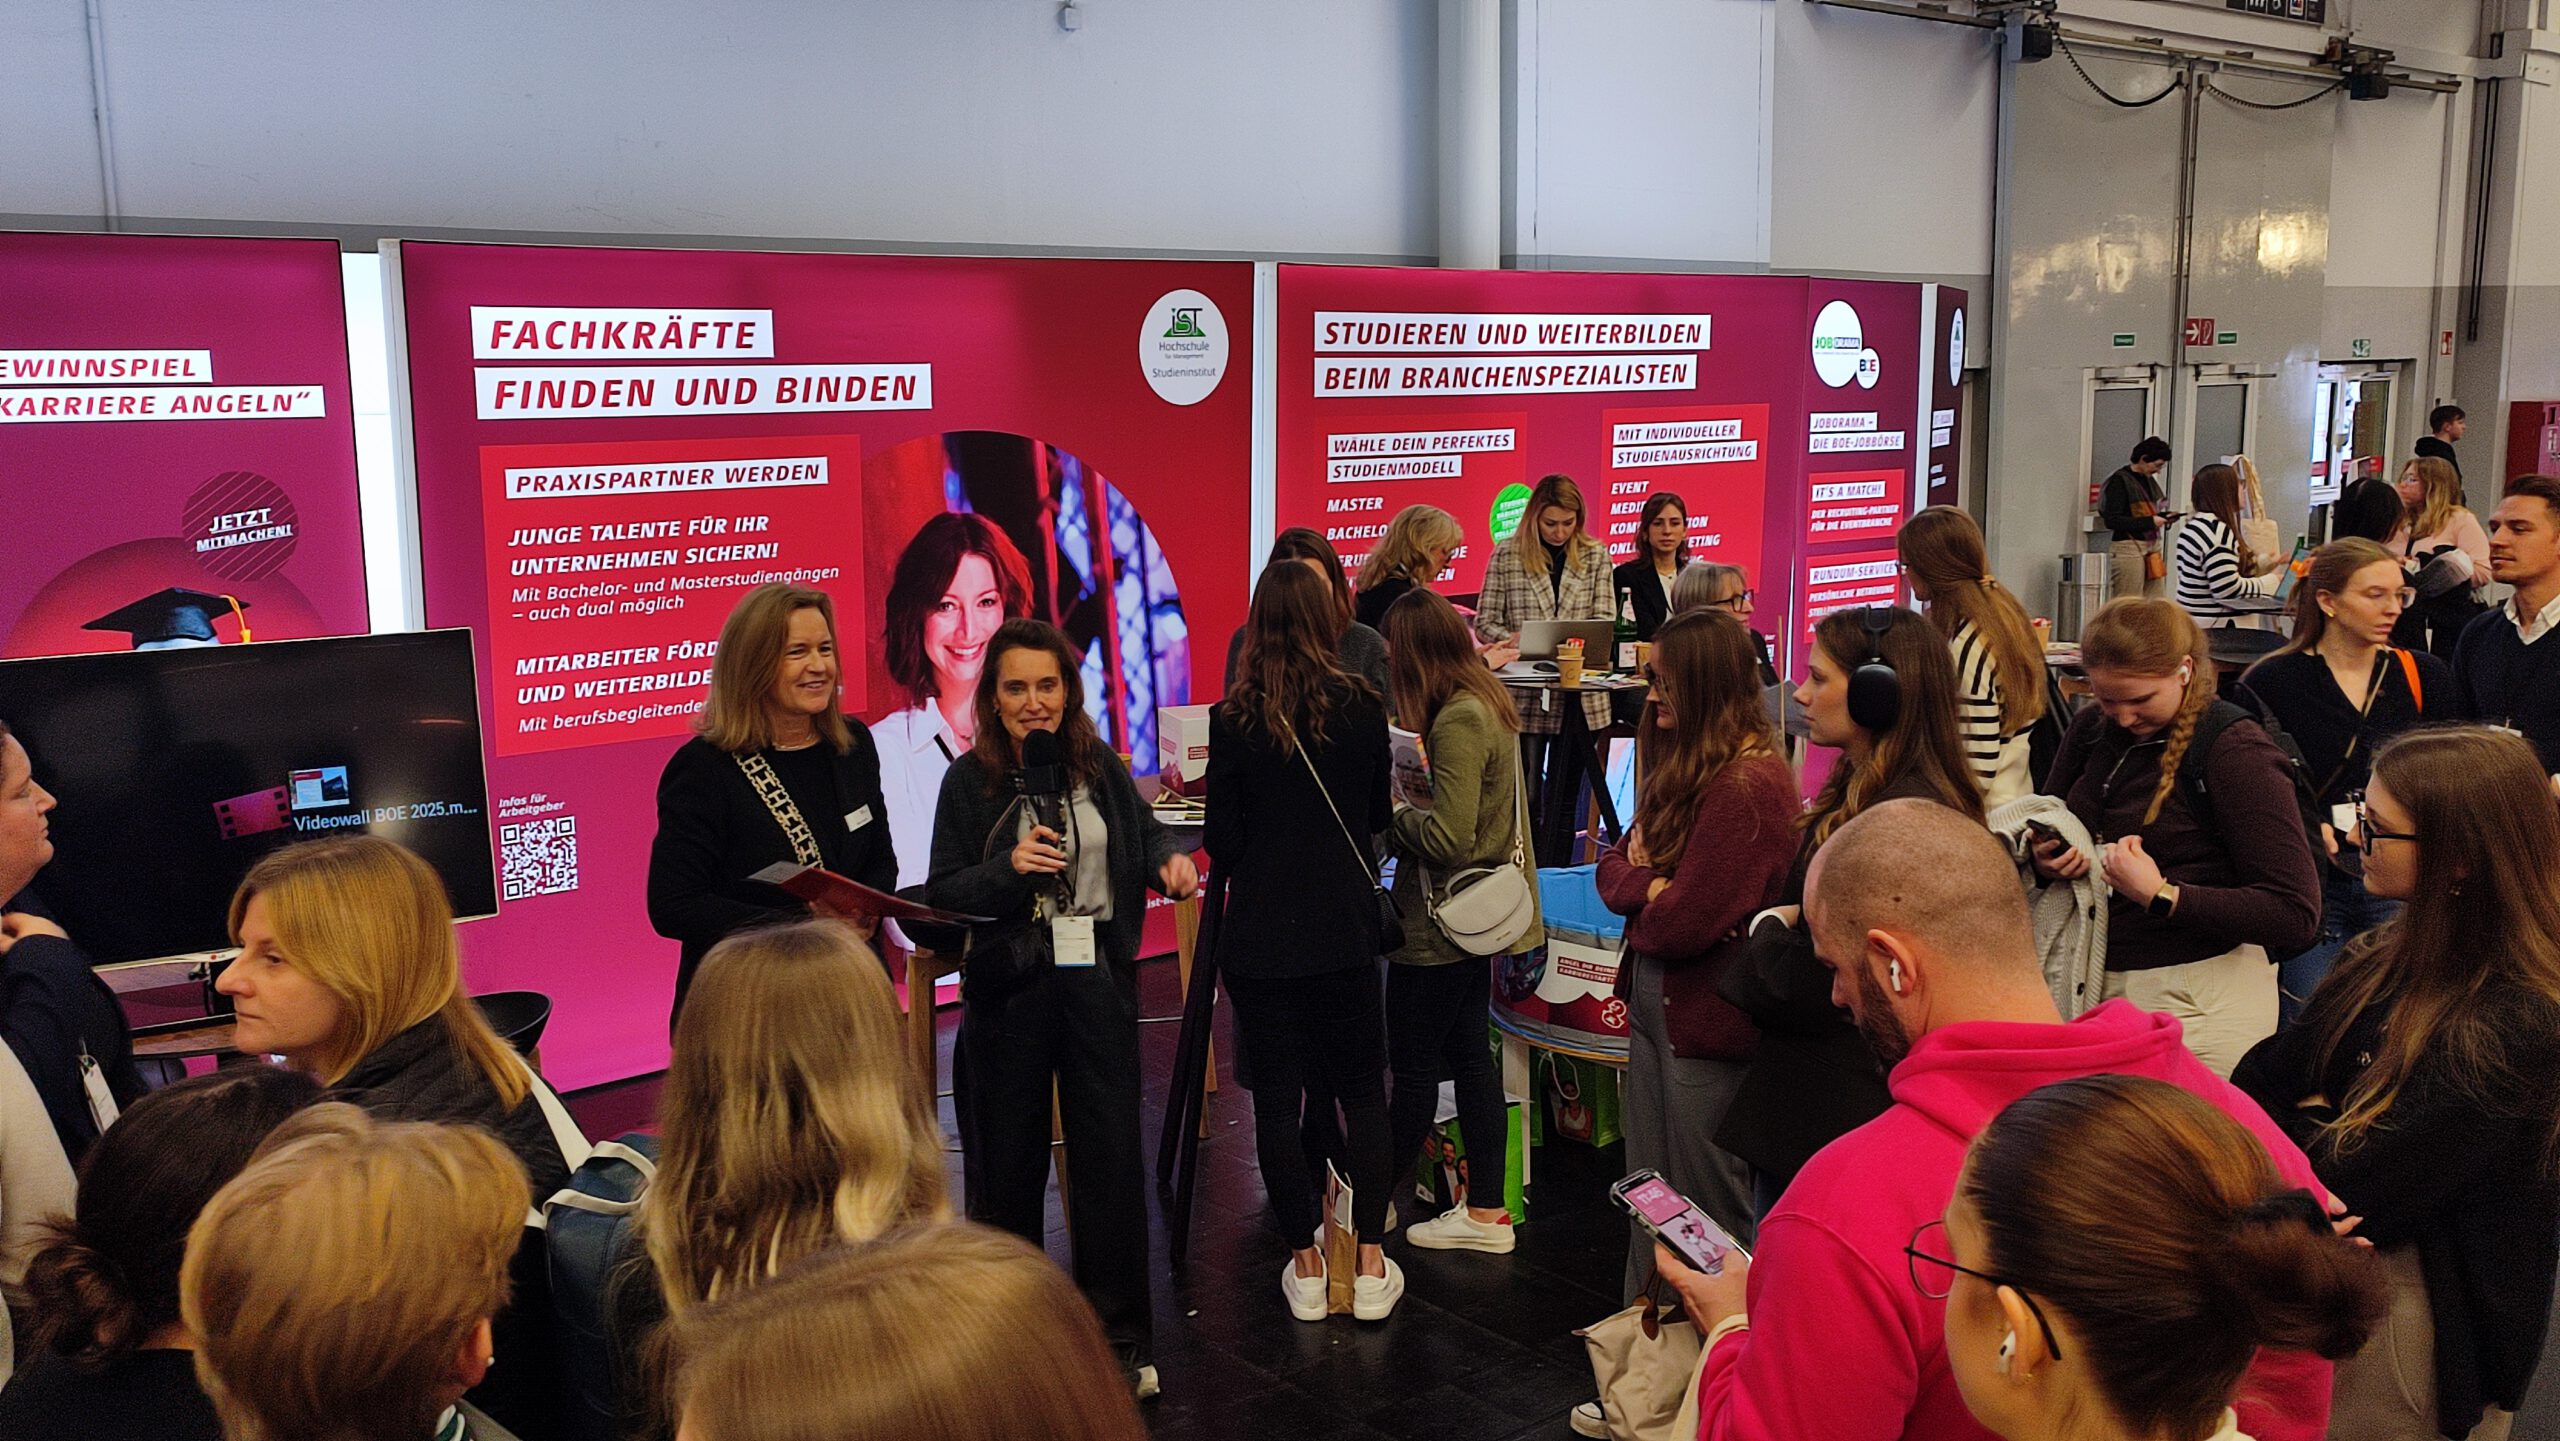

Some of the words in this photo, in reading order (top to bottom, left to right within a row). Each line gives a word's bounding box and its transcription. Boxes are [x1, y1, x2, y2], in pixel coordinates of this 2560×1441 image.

[489, 315, 757, 350] FACHKRÄFTE
[1324, 322, 1467, 346] STUDIEREN
[1476, 323, 1527, 345] UND
[1537, 323, 1702, 344] WEITERBILDEN
[1159, 341, 1210, 352] Hochschule
[1152, 367, 1217, 378] Studieninstitut
[1324, 366, 1391, 390] BEIM
[1401, 362, 1688, 389] BRANCHENSPEZIALISTEN
[494, 379, 655, 410] FINDEN
[675, 377, 758, 407] UND
[775, 375, 916, 404] BINDEN
[1617, 428, 1642, 442] MIT
[1646, 424, 1737, 440] INDIVIDUELLER
[1813, 416, 1866, 429] JOBORAMA
[1333, 436, 1387, 453] WÄHLE
[1392, 436, 1427, 451] DEIN
[1432, 433, 1510, 450] PERFEKTES
[1813, 438, 1829, 450] DIE
[1617, 445, 1753, 464] STUDIENAUSRICHTUNG
[515, 467, 715, 493] PRAXISPARTNER
[724, 463, 820, 484] WERDEN
[1333, 460, 1456, 479] STUDIENMODELL
[1611, 480, 1650, 496] EVENT
[1326, 497, 1384, 513] MASTER
[1610, 500, 1647, 516] MEDI
[209, 507, 272, 532] JETZT
[196, 523, 293, 552] MITMACHEN!
[508, 526, 583, 547] JUNGE
[590, 519, 681, 543] TALENTE
[688, 515, 727, 537] FÜR
[734, 515, 769, 533] IHR
[1326, 524, 1389, 541] BACHELO
[510, 548, 679, 577] UNTERNEHMEN
[685, 542, 779, 565] SICHERN!
[1813, 564, 1894, 582] RUNDUM-SERVICE
[512, 586, 541, 604] Mit
[547, 582, 628, 601] Bachelor-
[634, 577, 665, 595] und
[670, 565, 840, 593] Masterstudiengängen
[528, 604, 571, 622] auch
[576, 600, 614, 617] dual
[619, 594, 685, 618] möglich
[515, 645, 661, 676] MITARBEITER
[666, 639, 719, 661] FÖRD
[517, 684, 566, 705] UND
[574, 667, 713, 700] WEITERBILDE
[518, 717, 547, 734] Mit
[552, 699, 706, 730] berufsbegleitende
[498, 796, 528, 809] Infos
[530, 793, 548, 805] für
[498, 801, 566, 819] Arbeitgeber
[294, 811, 370, 832] Videowall
[376, 805, 407, 823] BOE
